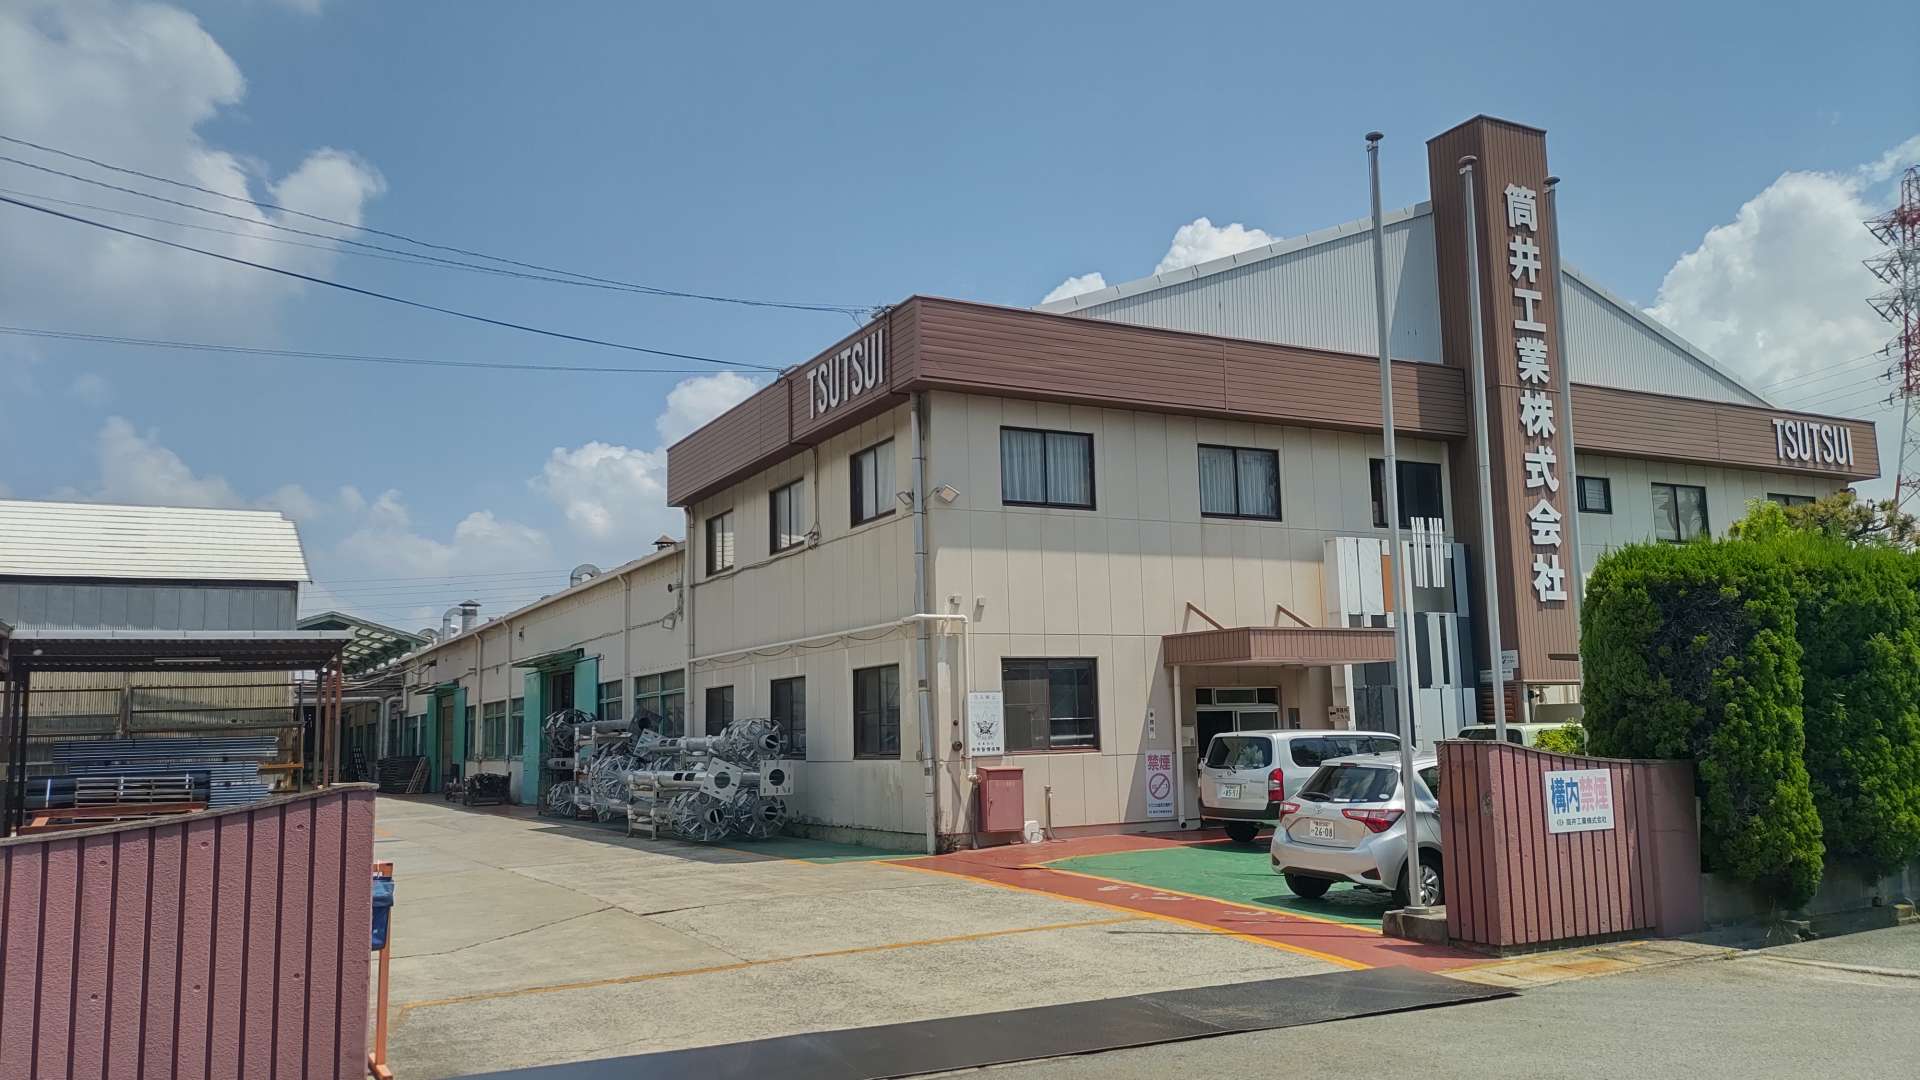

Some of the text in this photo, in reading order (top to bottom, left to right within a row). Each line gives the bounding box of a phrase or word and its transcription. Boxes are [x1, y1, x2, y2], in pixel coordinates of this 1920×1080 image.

[807, 328, 883, 419] TSUTSUI
[1504, 183, 1567, 602] 筒井工業株式会社
[1772, 418, 1854, 466] TSUTSUI
